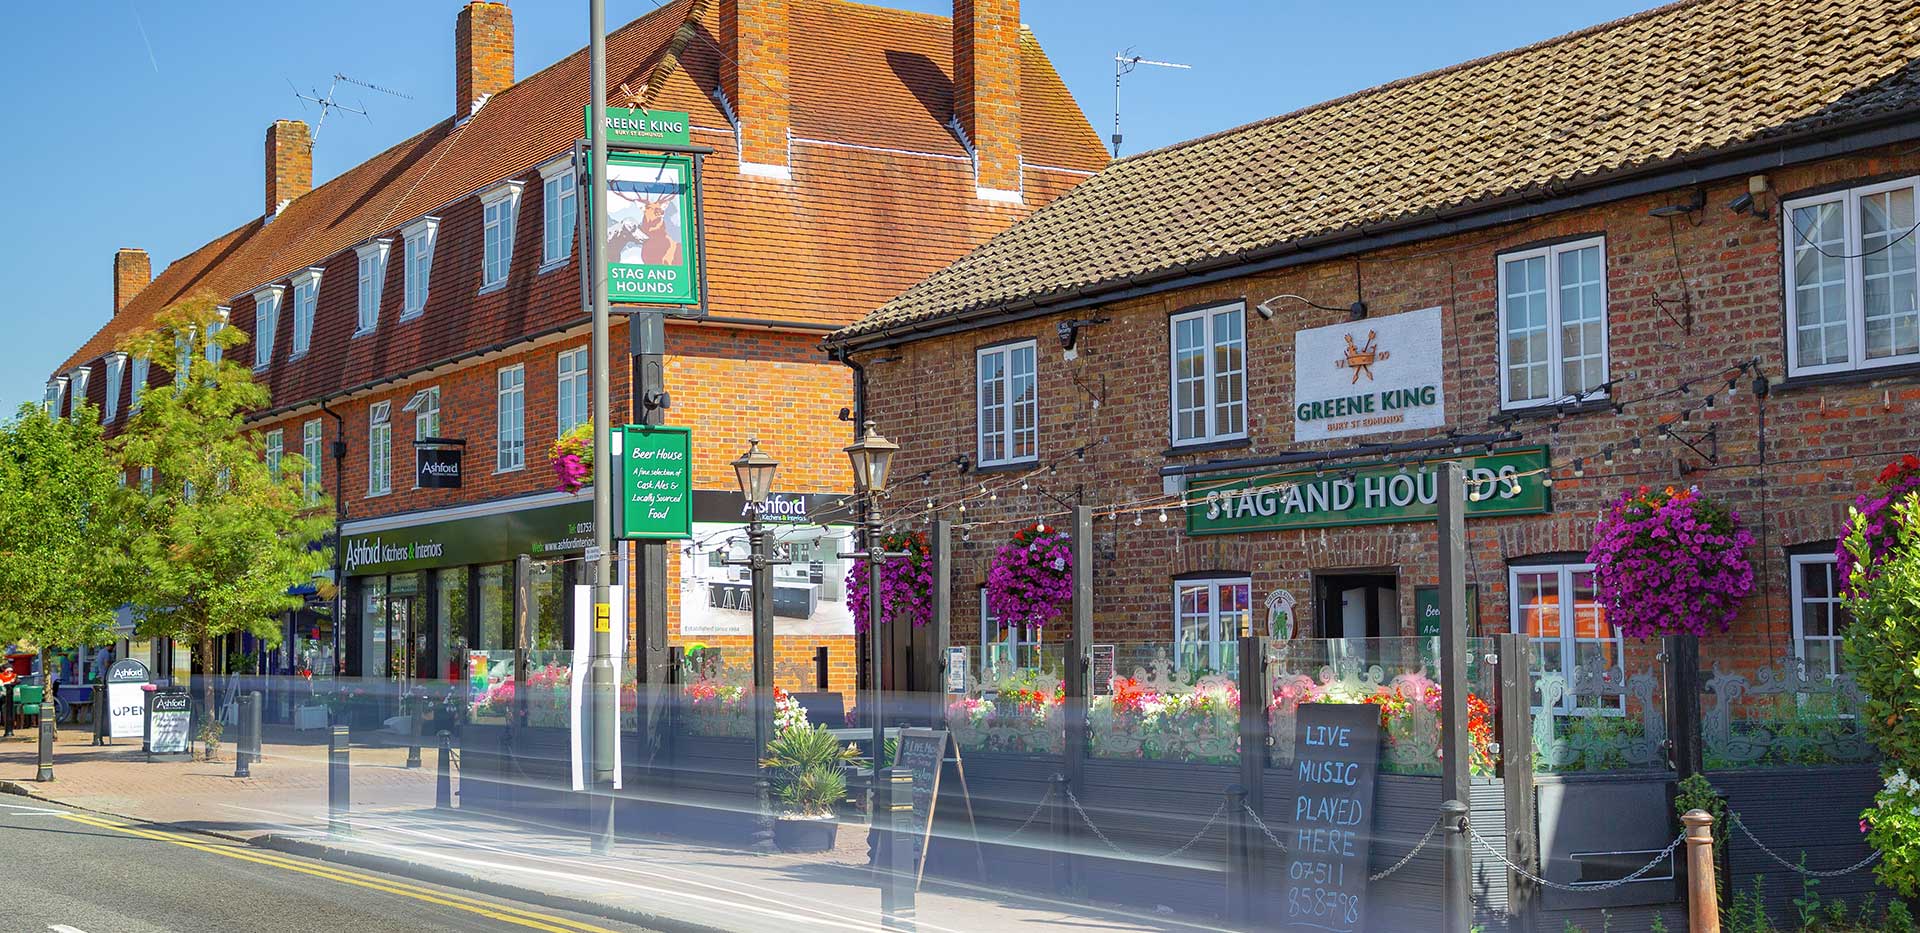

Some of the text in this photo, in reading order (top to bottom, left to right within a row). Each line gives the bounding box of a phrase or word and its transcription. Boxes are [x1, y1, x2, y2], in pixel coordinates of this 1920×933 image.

[606, 117, 682, 133] REENE KING
[612, 268, 677, 282] STAG AND
[616, 281, 674, 294] HOUNDS
[1297, 385, 1436, 422] GREENE KING
[1327, 414, 1404, 432] BURY ST EDMUNDS
[632, 448, 683, 461] Beer House
[421, 461, 458, 474] Ashford
[638, 467, 650, 477] fine
[650, 468, 675, 476] selection
[675, 468, 682, 477] of
[637, 480, 679, 490] Cask Ales &
[1206, 465, 1517, 520] STAG AND HOUDS
[632, 493, 683, 506] Locally Sourced
[648, 506, 670, 519] Food
[345, 537, 442, 570] Ashford Kitchens & Interiors
[596, 606, 610, 629] H
[1425, 604, 1440, 617] Bee
[113, 668, 143, 679] Ashford
[156, 699, 186, 709] Ashford
[1306, 725, 1351, 747] LIVE
[1298, 759, 1360, 786] MUSIC
[1296, 795, 1363, 826] PLAYED
[1297, 828, 1356, 857] HERE
[1290, 860, 1344, 886] 07511
